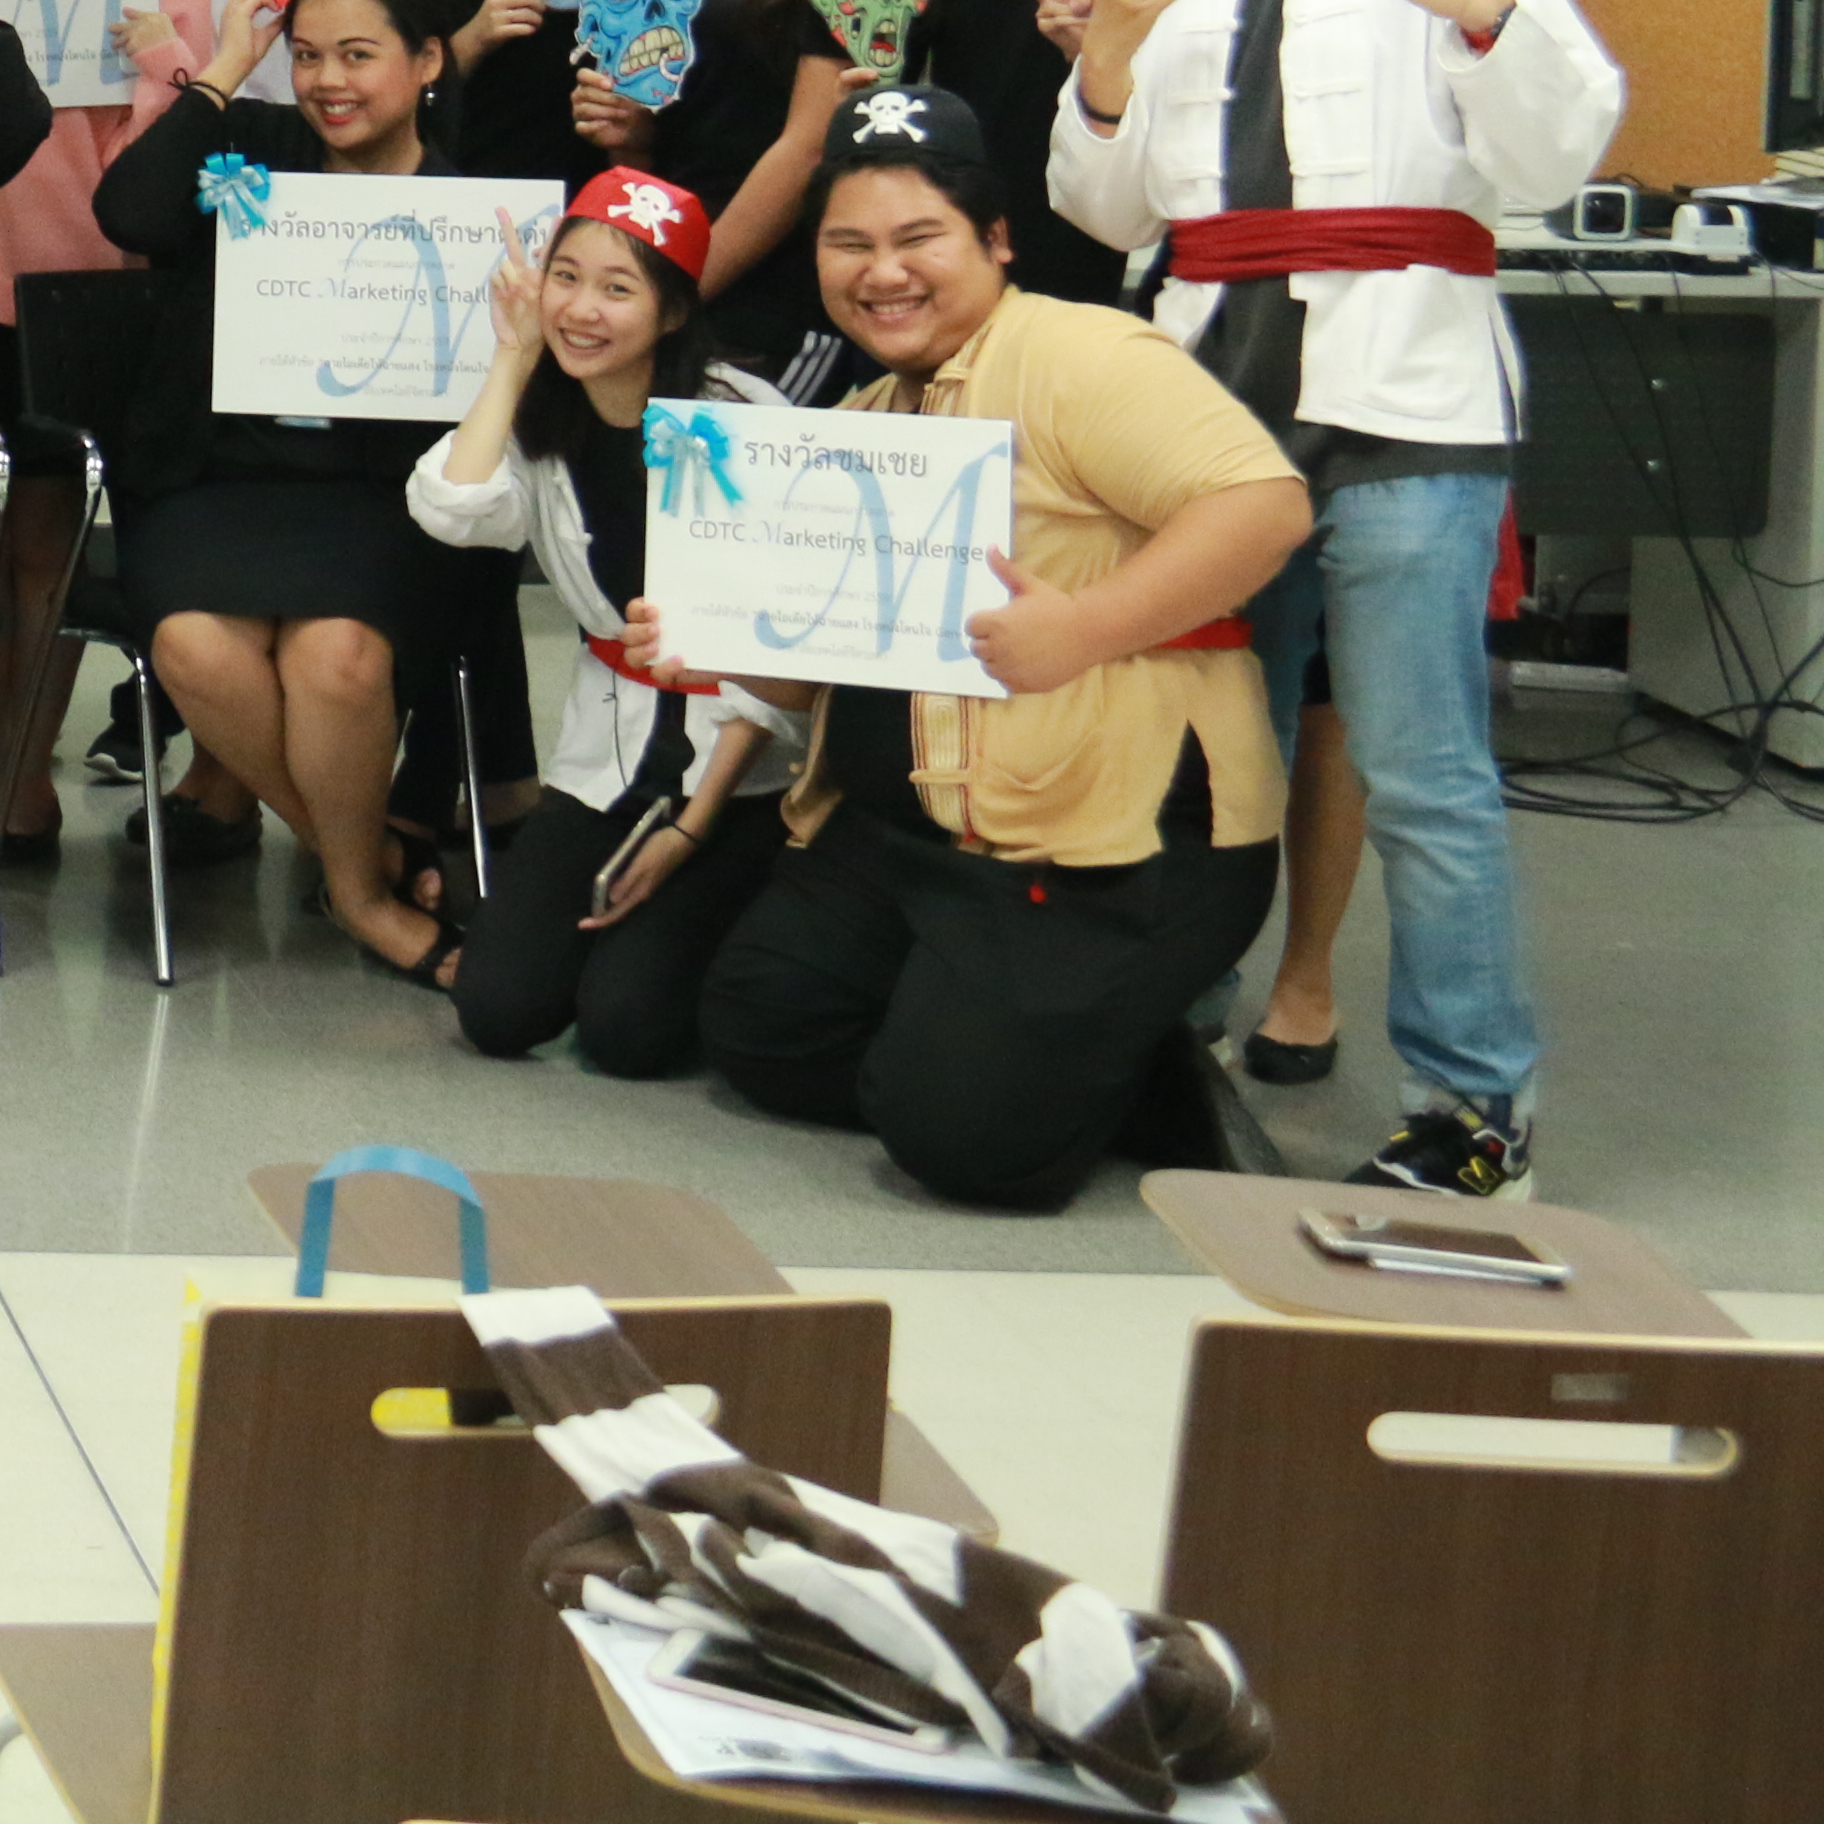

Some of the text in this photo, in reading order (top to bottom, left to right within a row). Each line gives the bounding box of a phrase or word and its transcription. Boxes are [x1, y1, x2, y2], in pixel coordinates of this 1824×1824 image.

[256, 276, 489, 306] CDTC Marketing Chall
[744, 433, 928, 478] รางวัลชมเชย
[689, 520, 984, 564] CDTC Marketing Challenge
